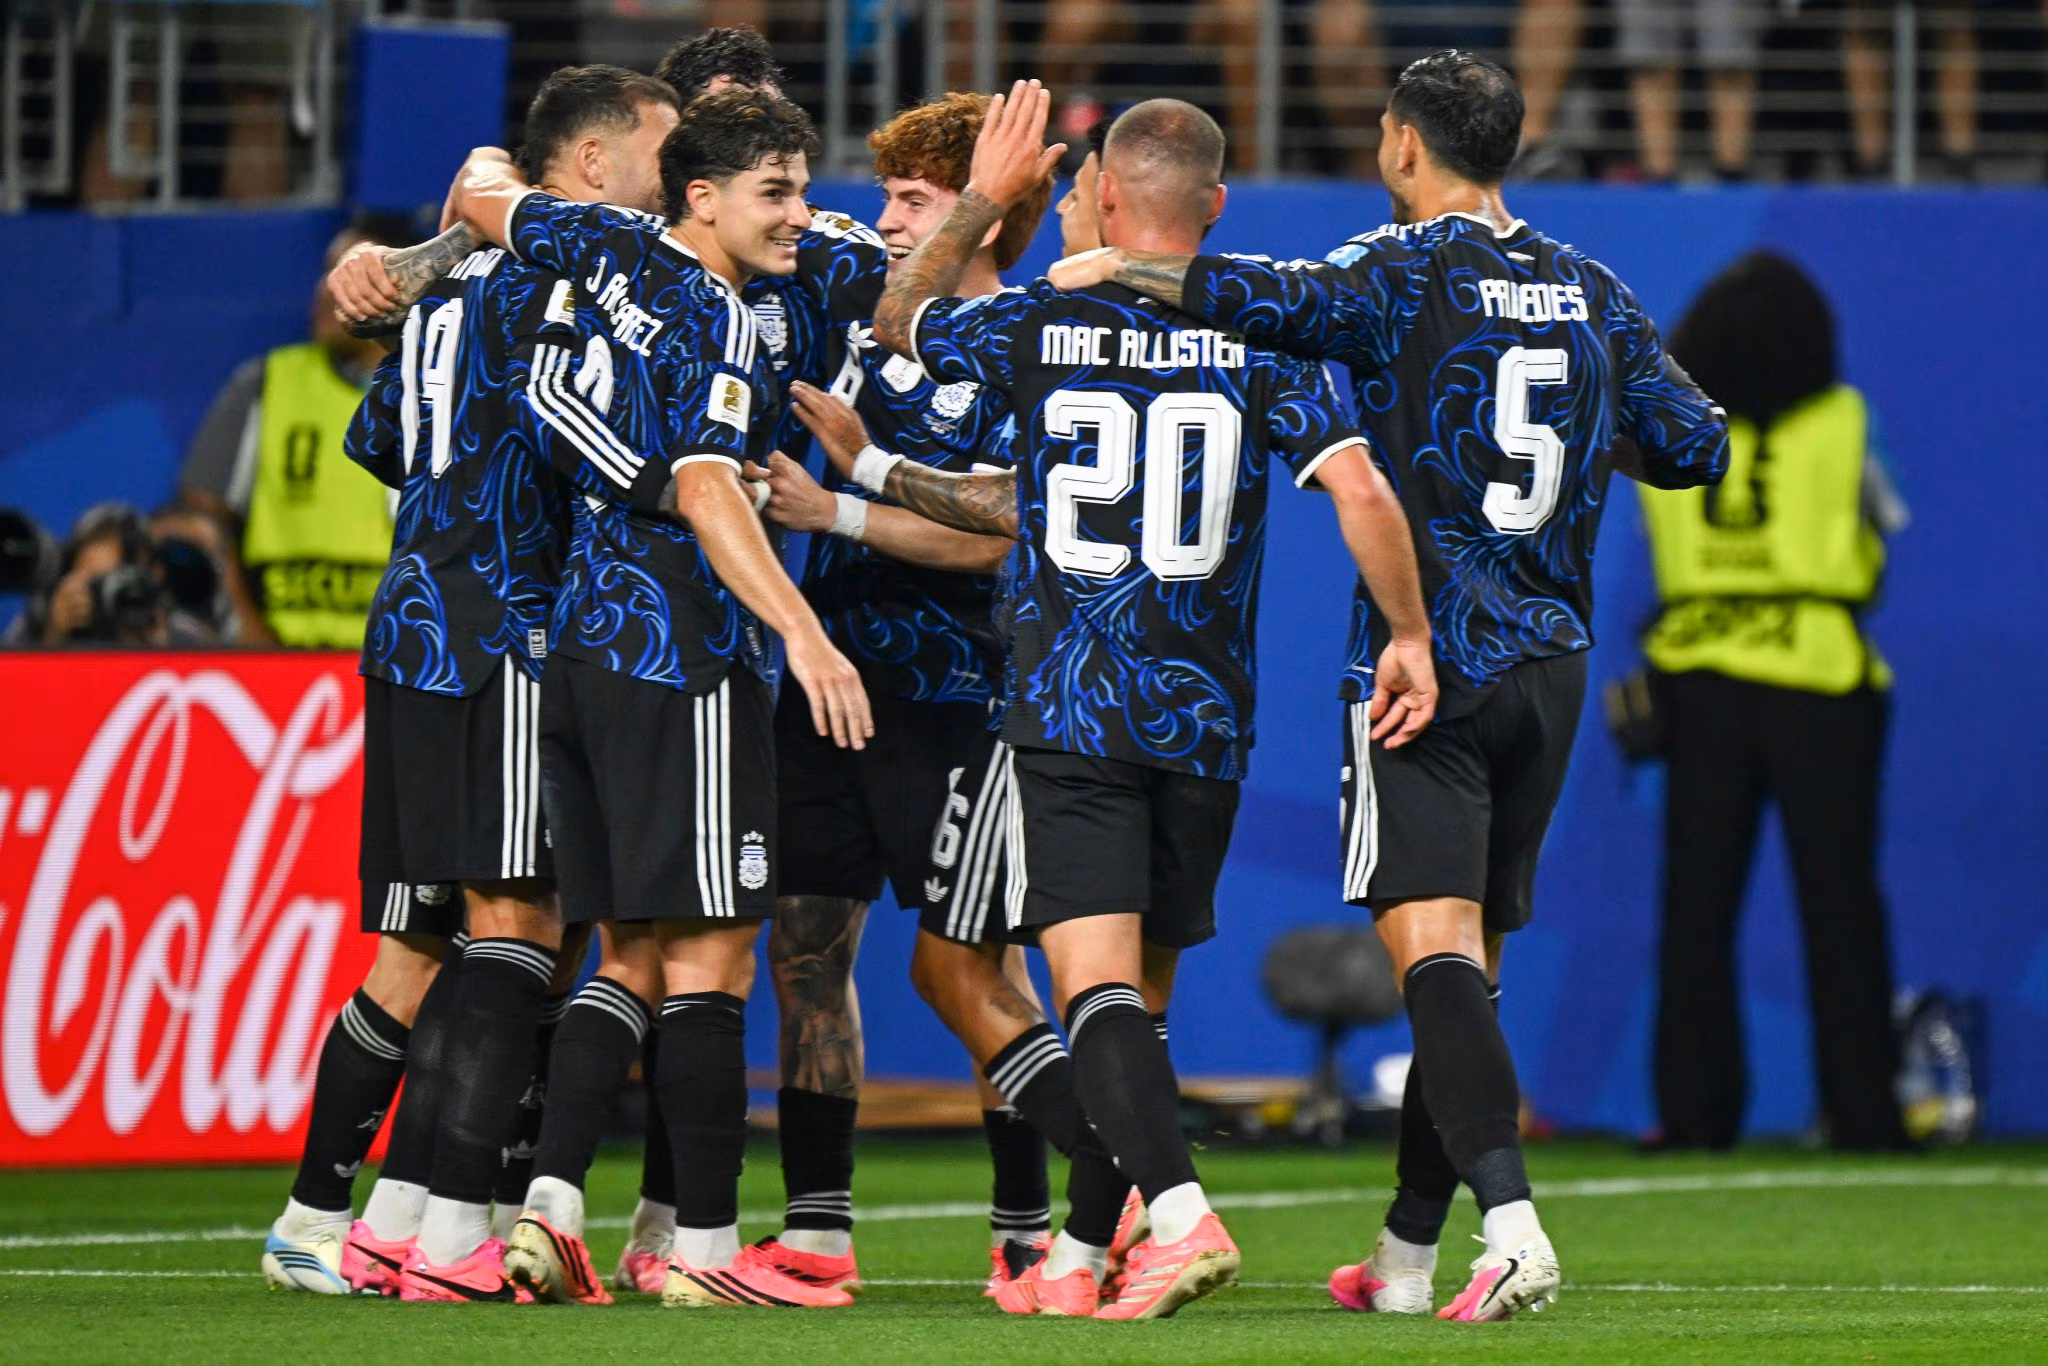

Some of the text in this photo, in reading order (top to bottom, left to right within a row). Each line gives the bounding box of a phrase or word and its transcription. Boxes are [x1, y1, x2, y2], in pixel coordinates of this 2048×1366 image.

[400, 298, 464, 479] 19
[596, 273, 664, 357] AAREZ
[1041, 325, 1246, 369] MAC ALLISTER
[1044, 389, 1241, 581] 20
[1482, 346, 1568, 536] 5
